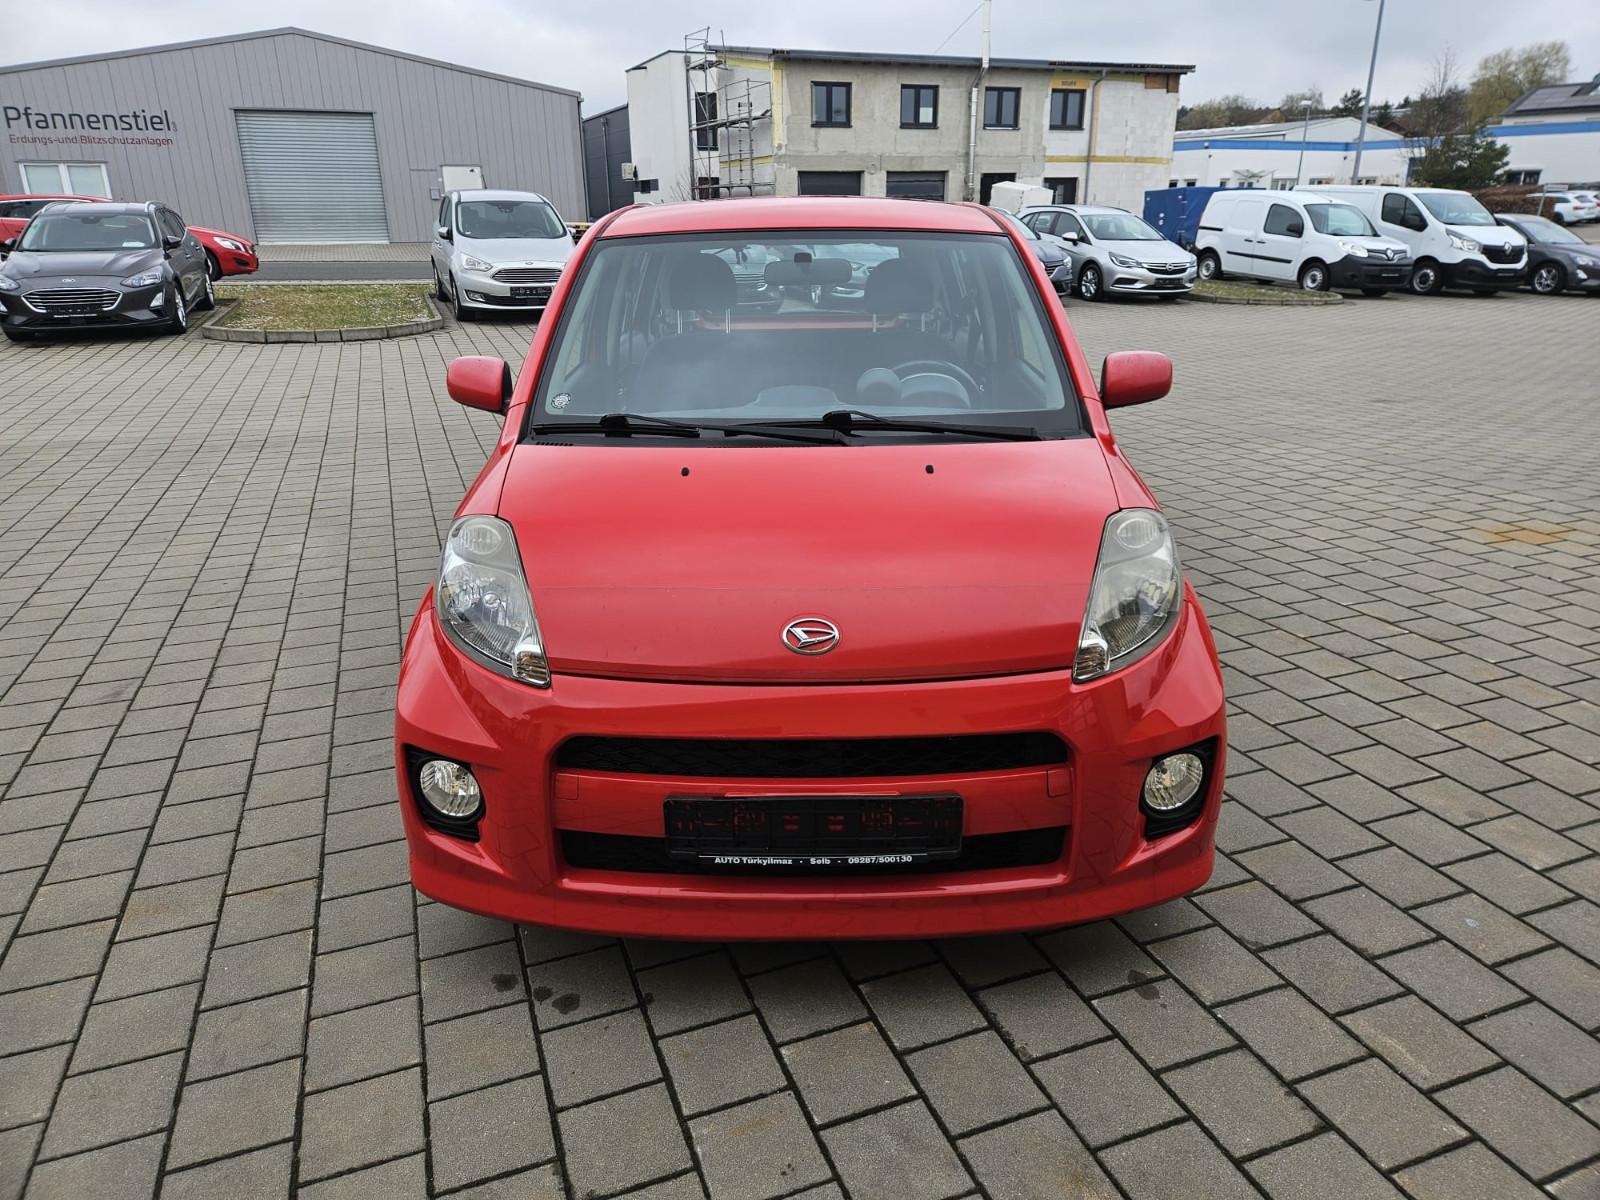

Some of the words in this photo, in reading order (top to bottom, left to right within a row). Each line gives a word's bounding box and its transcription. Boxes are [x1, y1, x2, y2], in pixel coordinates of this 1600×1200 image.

[3, 106, 171, 132] Pfannenstiel
[80, 135, 174, 147] Blitzschutzanlagen
[810, 857, 831, 865] Selb
[848, 855, 913, 865] 09287/500130
